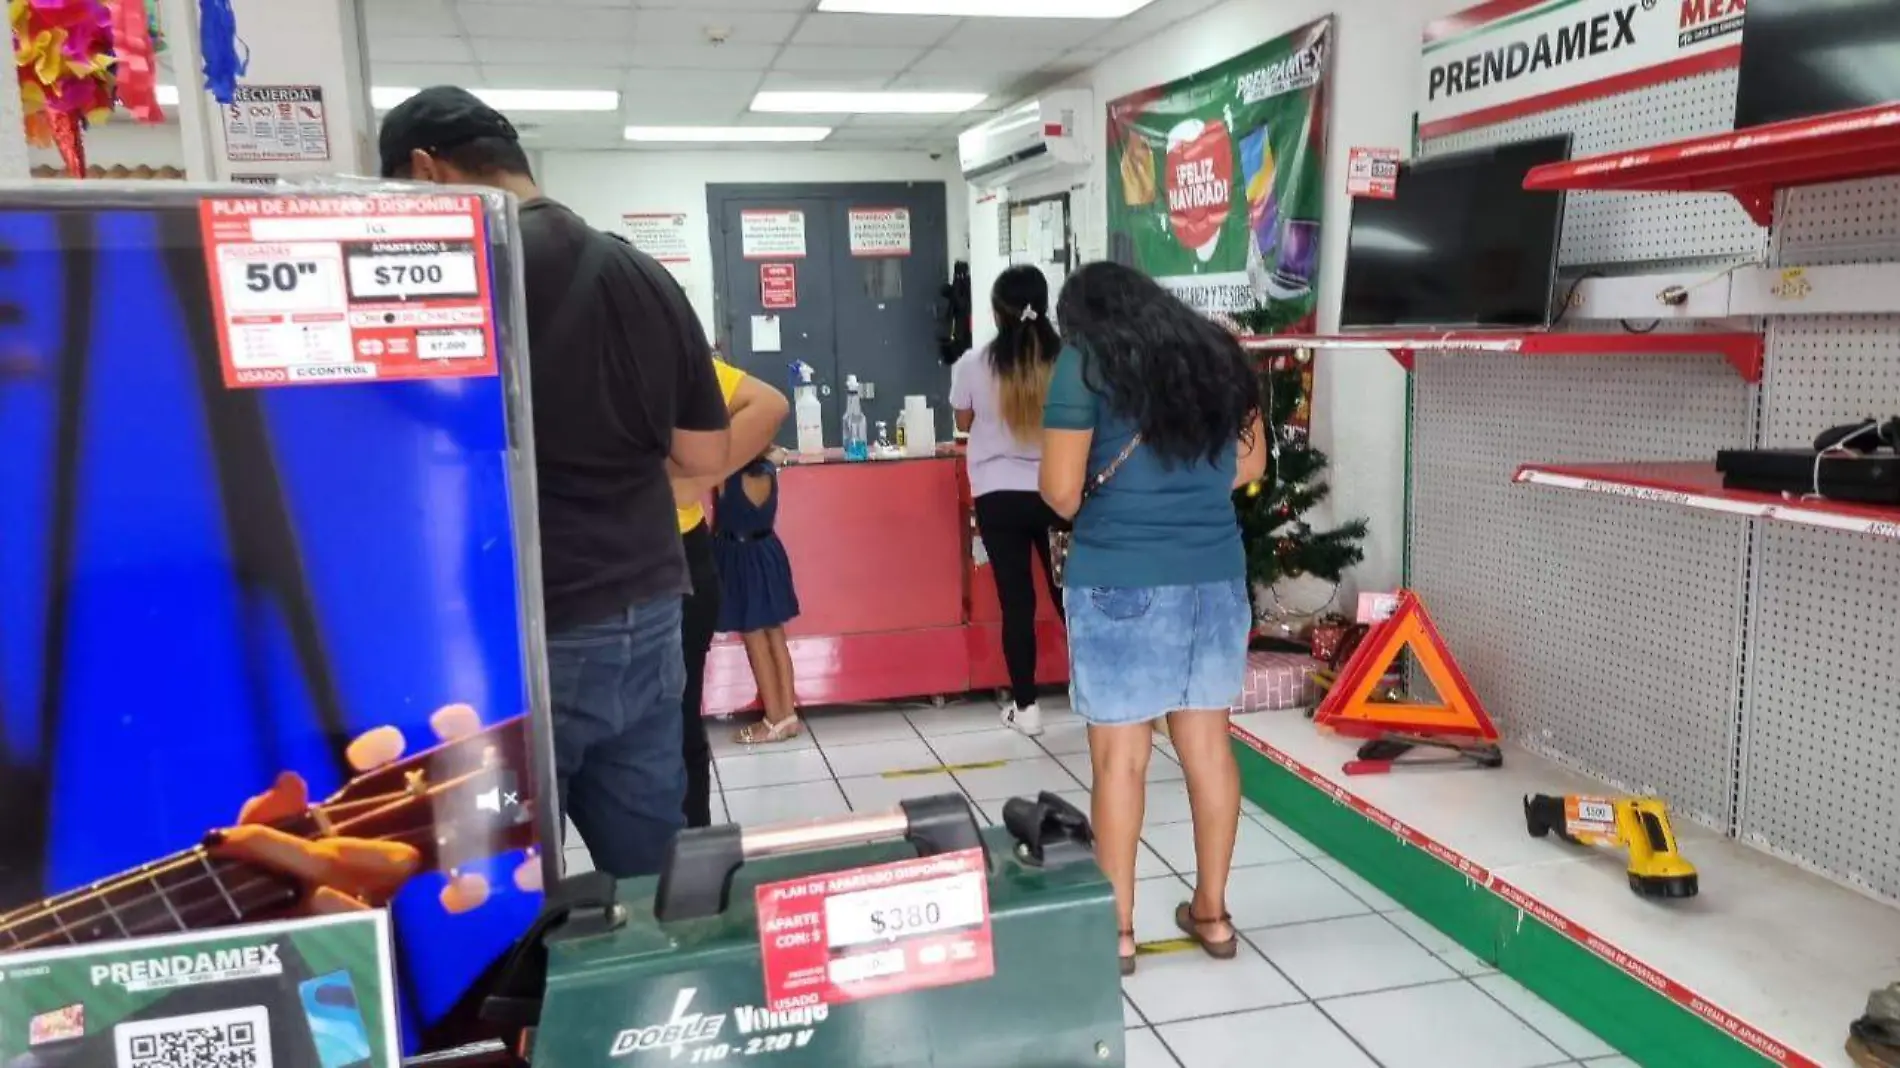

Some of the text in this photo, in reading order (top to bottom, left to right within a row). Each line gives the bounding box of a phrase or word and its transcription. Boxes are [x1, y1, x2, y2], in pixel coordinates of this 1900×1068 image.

[1429, 10, 1636, 101] PRENDAMEX
[212, 197, 472, 215] PLAN DE APARTADO DISPONIBLE
[1169, 179, 1229, 210] NAVIDAD!
[247, 262, 317, 292] 50"
[375, 264, 442, 285] $700
[237, 370, 286, 383] USADO
[774, 886, 807, 899] PLAN
[809, 882, 826, 893] DE
[828, 870, 893, 890] APARTADO
[766, 912, 820, 933] APARTE
[871, 902, 942, 934] $380
[90, 943, 280, 986] PRENDAMEX
[774, 993, 819, 1009] USADO
[609, 1014, 726, 1056] DOBLE
